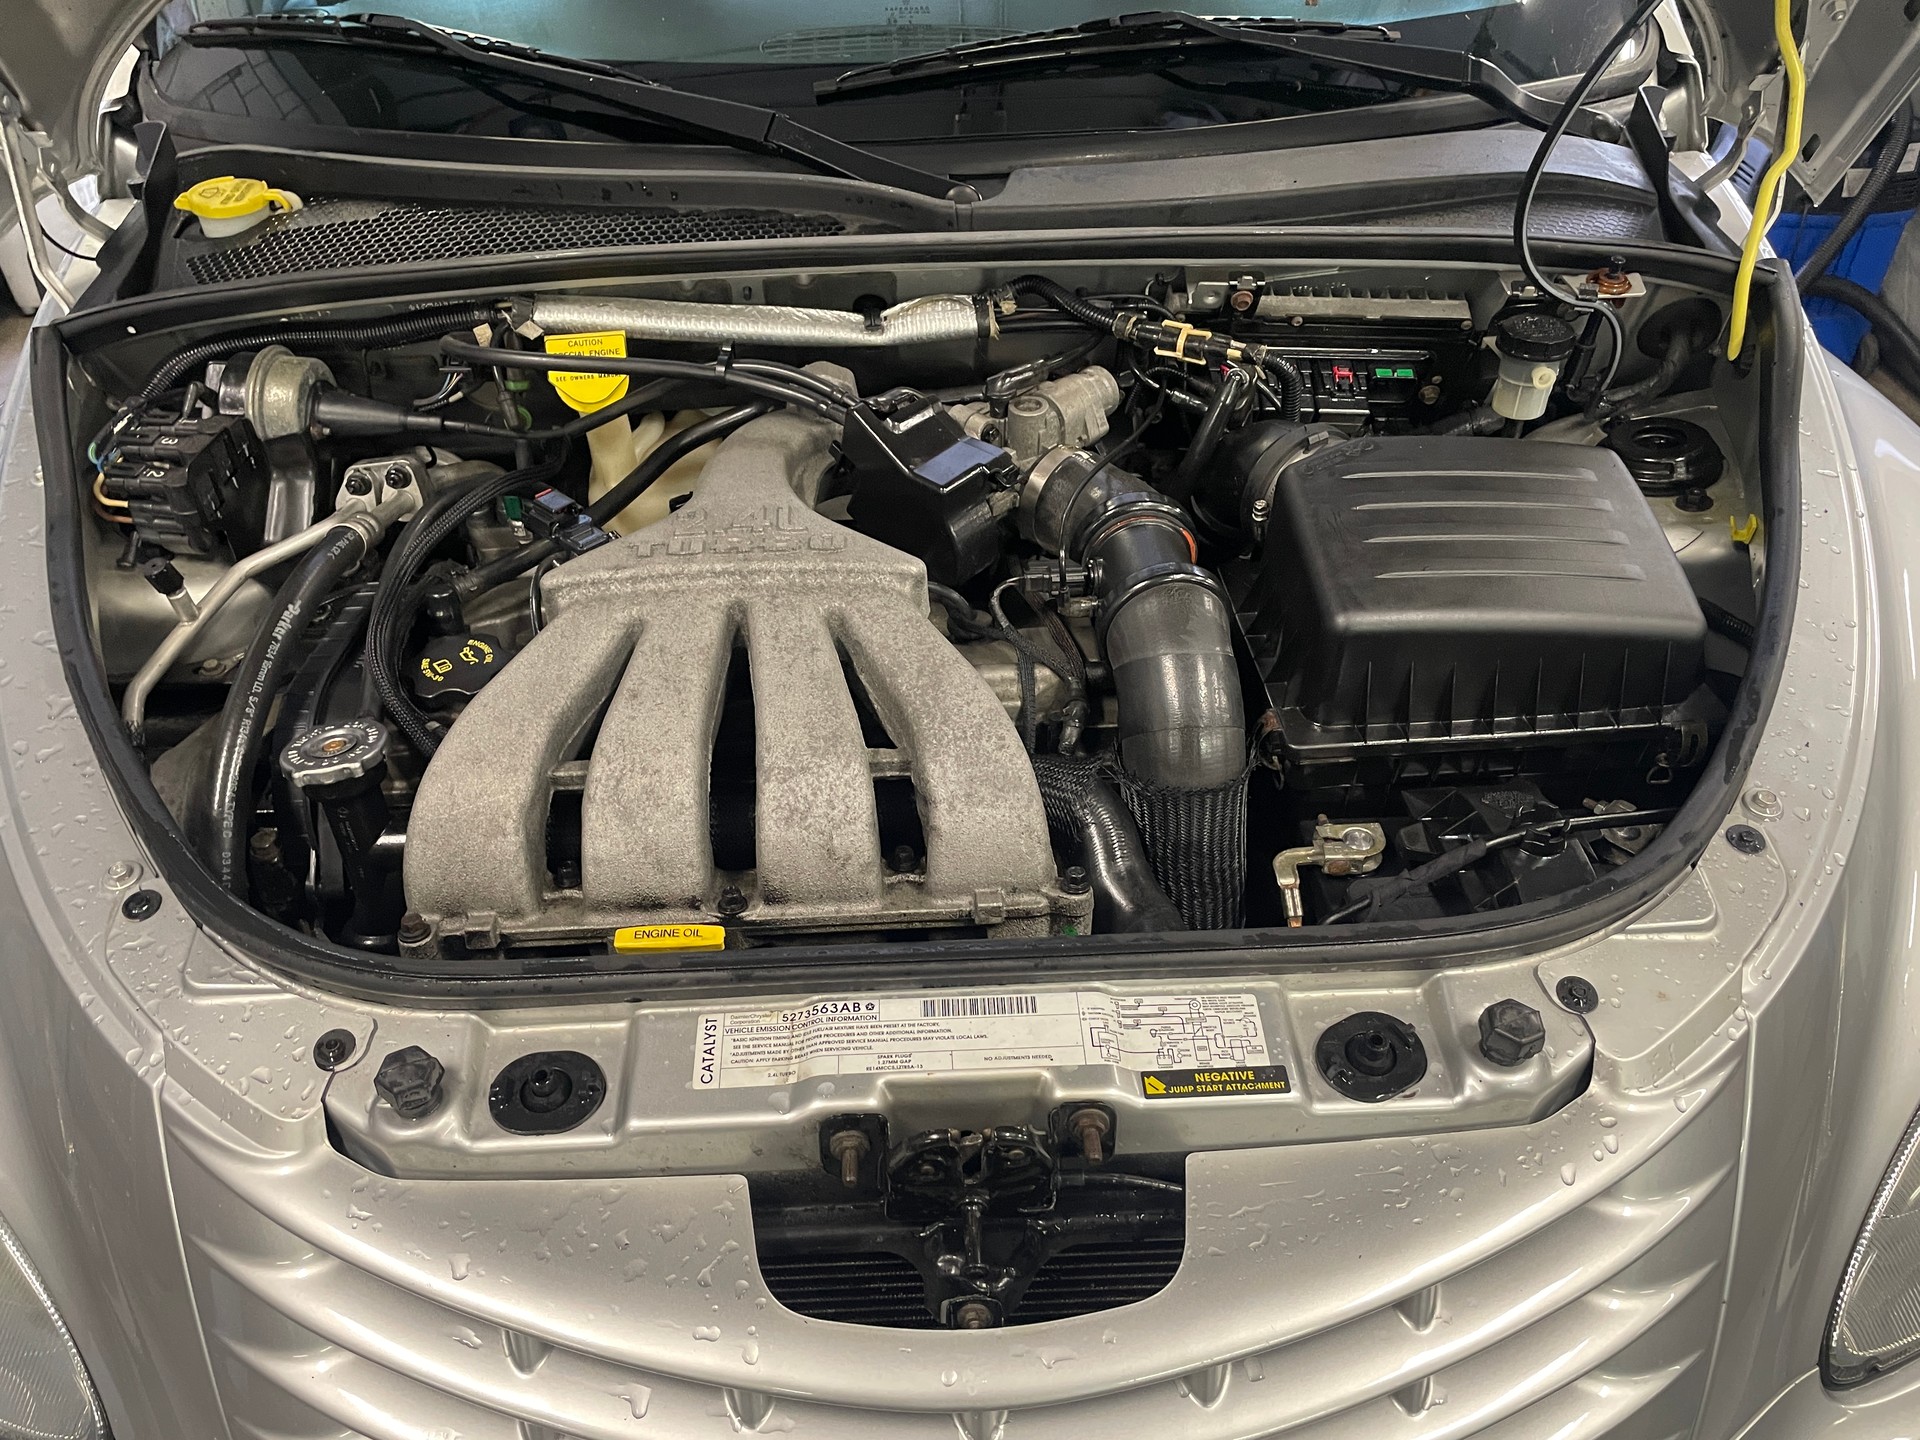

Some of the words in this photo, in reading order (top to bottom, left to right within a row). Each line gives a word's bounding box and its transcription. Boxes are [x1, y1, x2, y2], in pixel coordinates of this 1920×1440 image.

[568, 339, 603, 347] CAUTION
[589, 348, 620, 356] ENGINE
[626, 533, 848, 558] TURBO
[272, 600, 301, 640] Parker
[467, 639, 493, 654] ENGINE
[634, 928, 680, 939] ENGINE
[683, 928, 703, 938] OIL
[782, 1002, 861, 1022] 5273563AB
[756, 1025, 791, 1033] EMISSION
[792, 1017, 824, 1030] CONTROL
[700, 1018, 717, 1084] CATALYST
[1194, 1071, 1255, 1082] NEGATIVE
[1168, 1085, 1194, 1094] JUMP
[1196, 1084, 1223, 1092] START
[1226, 1081, 1286, 1091] ATTACHMENT
